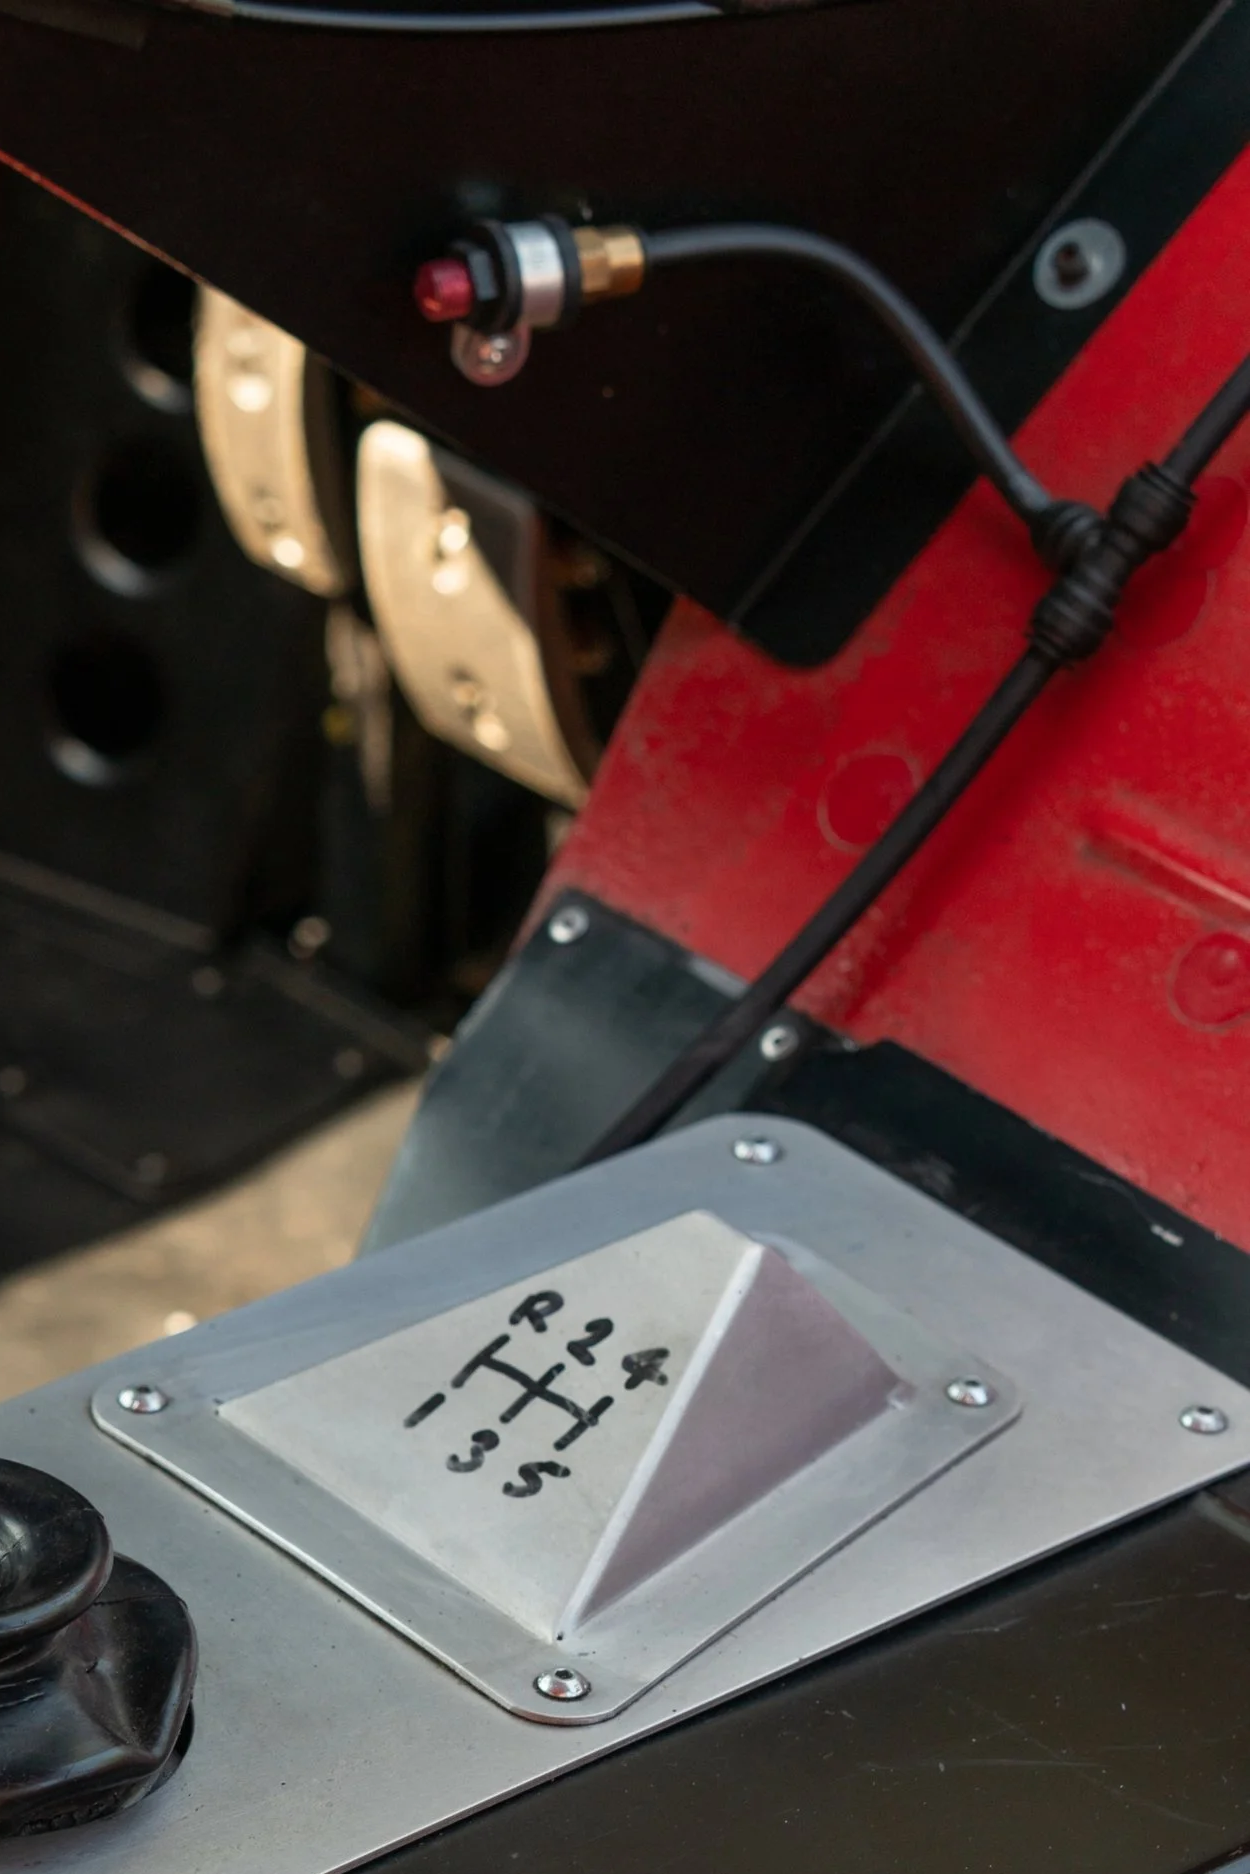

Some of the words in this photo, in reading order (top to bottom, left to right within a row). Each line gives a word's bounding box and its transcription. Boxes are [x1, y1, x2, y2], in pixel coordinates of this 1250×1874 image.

[509, 1290, 564, 1333] R
[566, 1317, 614, 1366] 2
[621, 1347, 670, 1390] 4
[445, 1429, 500, 1473] 3
[502, 1460, 571, 1498] 5
